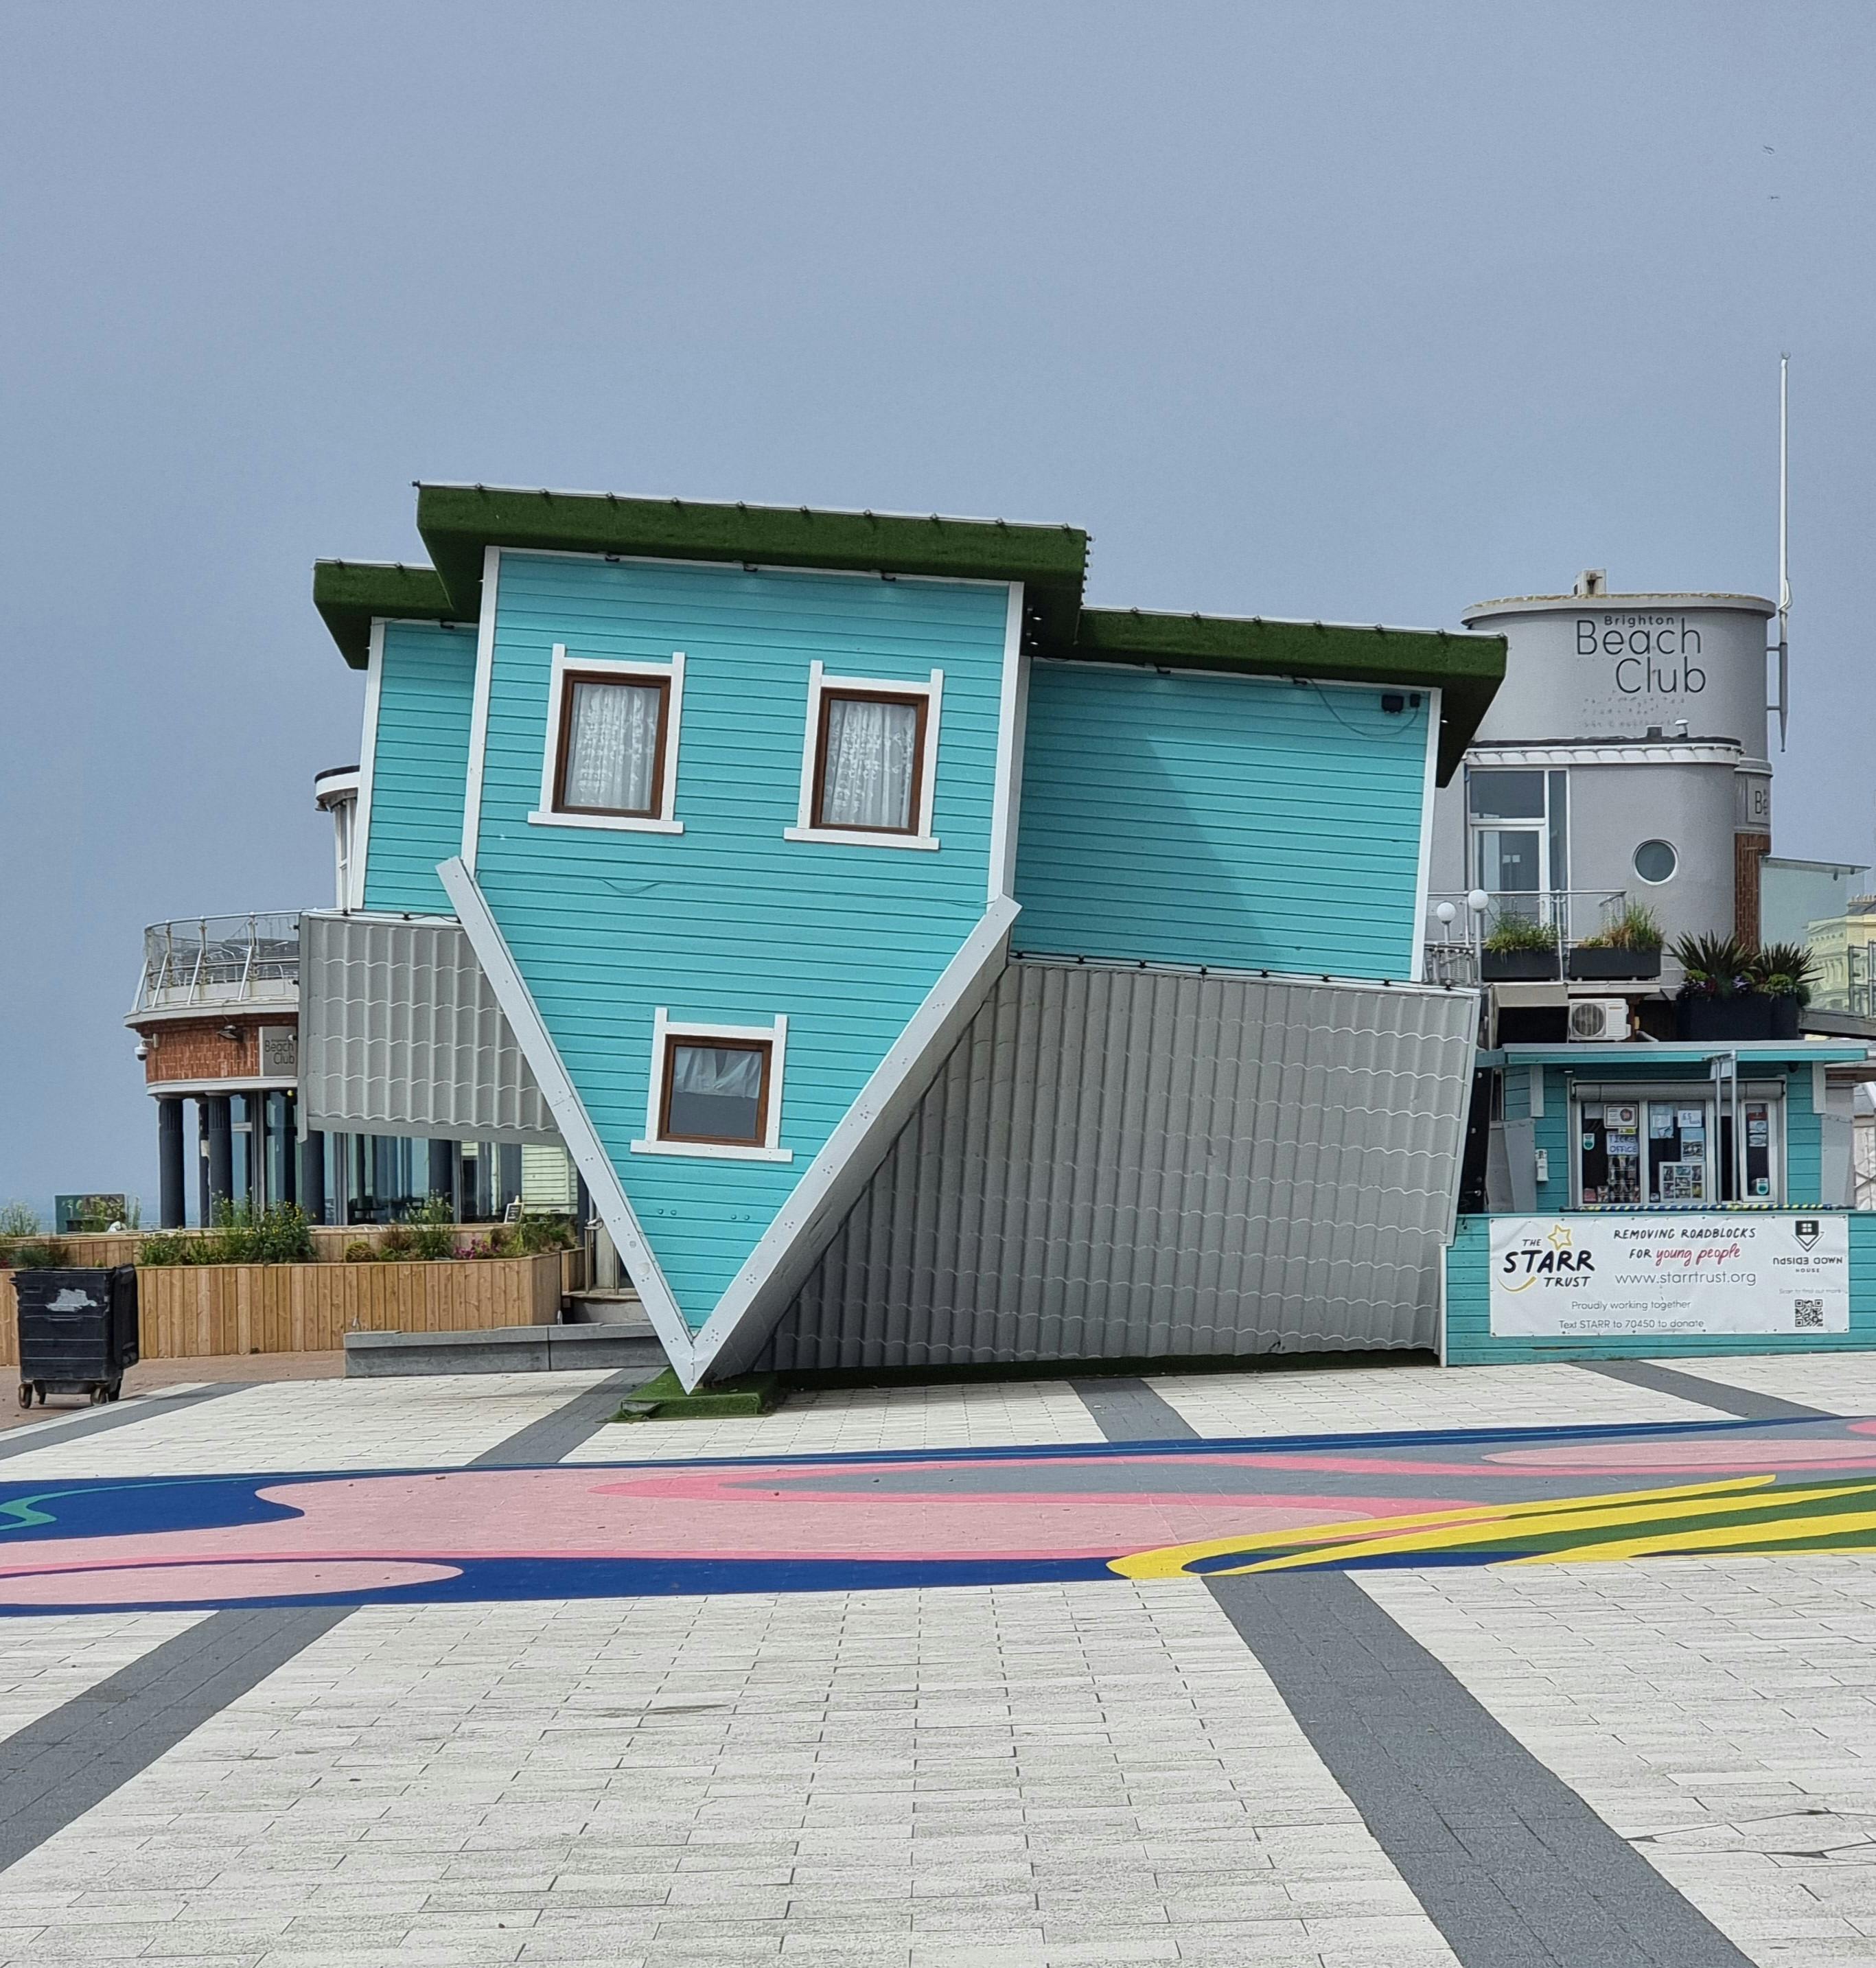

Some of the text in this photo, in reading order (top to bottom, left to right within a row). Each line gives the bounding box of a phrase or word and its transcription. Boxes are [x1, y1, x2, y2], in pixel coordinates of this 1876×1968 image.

[1604, 615, 1675, 628] Brighton
[1577, 617, 1701, 655] Beach
[1616, 656, 1706, 694] Club
[265, 1039, 294, 1052] Beach
[273, 1052, 295, 1065] Club
[1609, 1145, 1637, 1153] OFFICE
[1613, 1227, 1757, 1240] REMOVING ROADBLOCKS
[1522, 1238, 1542, 1247] THE
[1503, 1249, 1596, 1273] STARR
[1629, 1242, 1741, 1267] FOR young people
[1543, 1276, 1591, 1288] TRUST
[1614, 1271, 1757, 1286] www.starrtrust.org
[1571, 1300, 1691, 1311] Proudly working together
[1559, 1319, 1705, 1329] Text STARR to 70450 to donate
